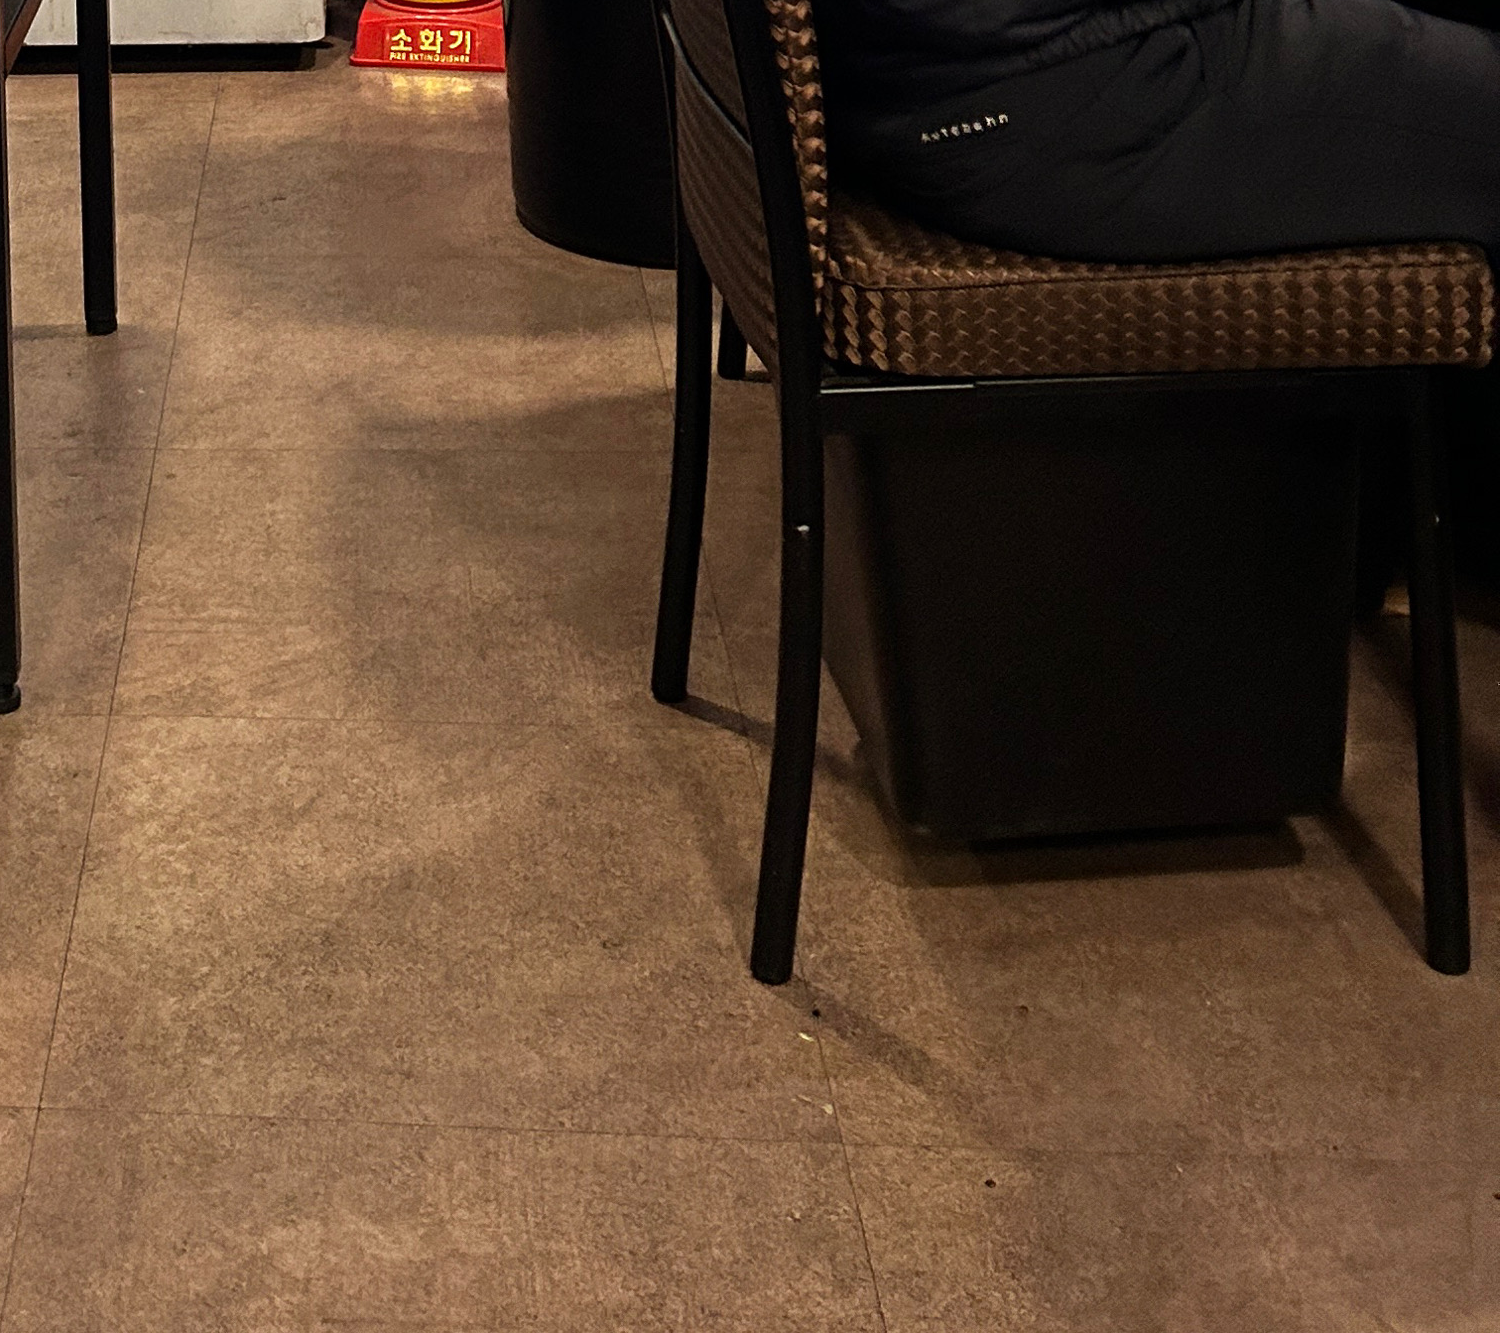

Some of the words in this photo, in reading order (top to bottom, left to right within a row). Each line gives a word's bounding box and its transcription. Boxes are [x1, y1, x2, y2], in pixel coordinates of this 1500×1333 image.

[390, 29, 471, 54] 소화기
[390, 52, 406, 61] FIRE
[410, 53, 470, 63] EXTINGUISHER
